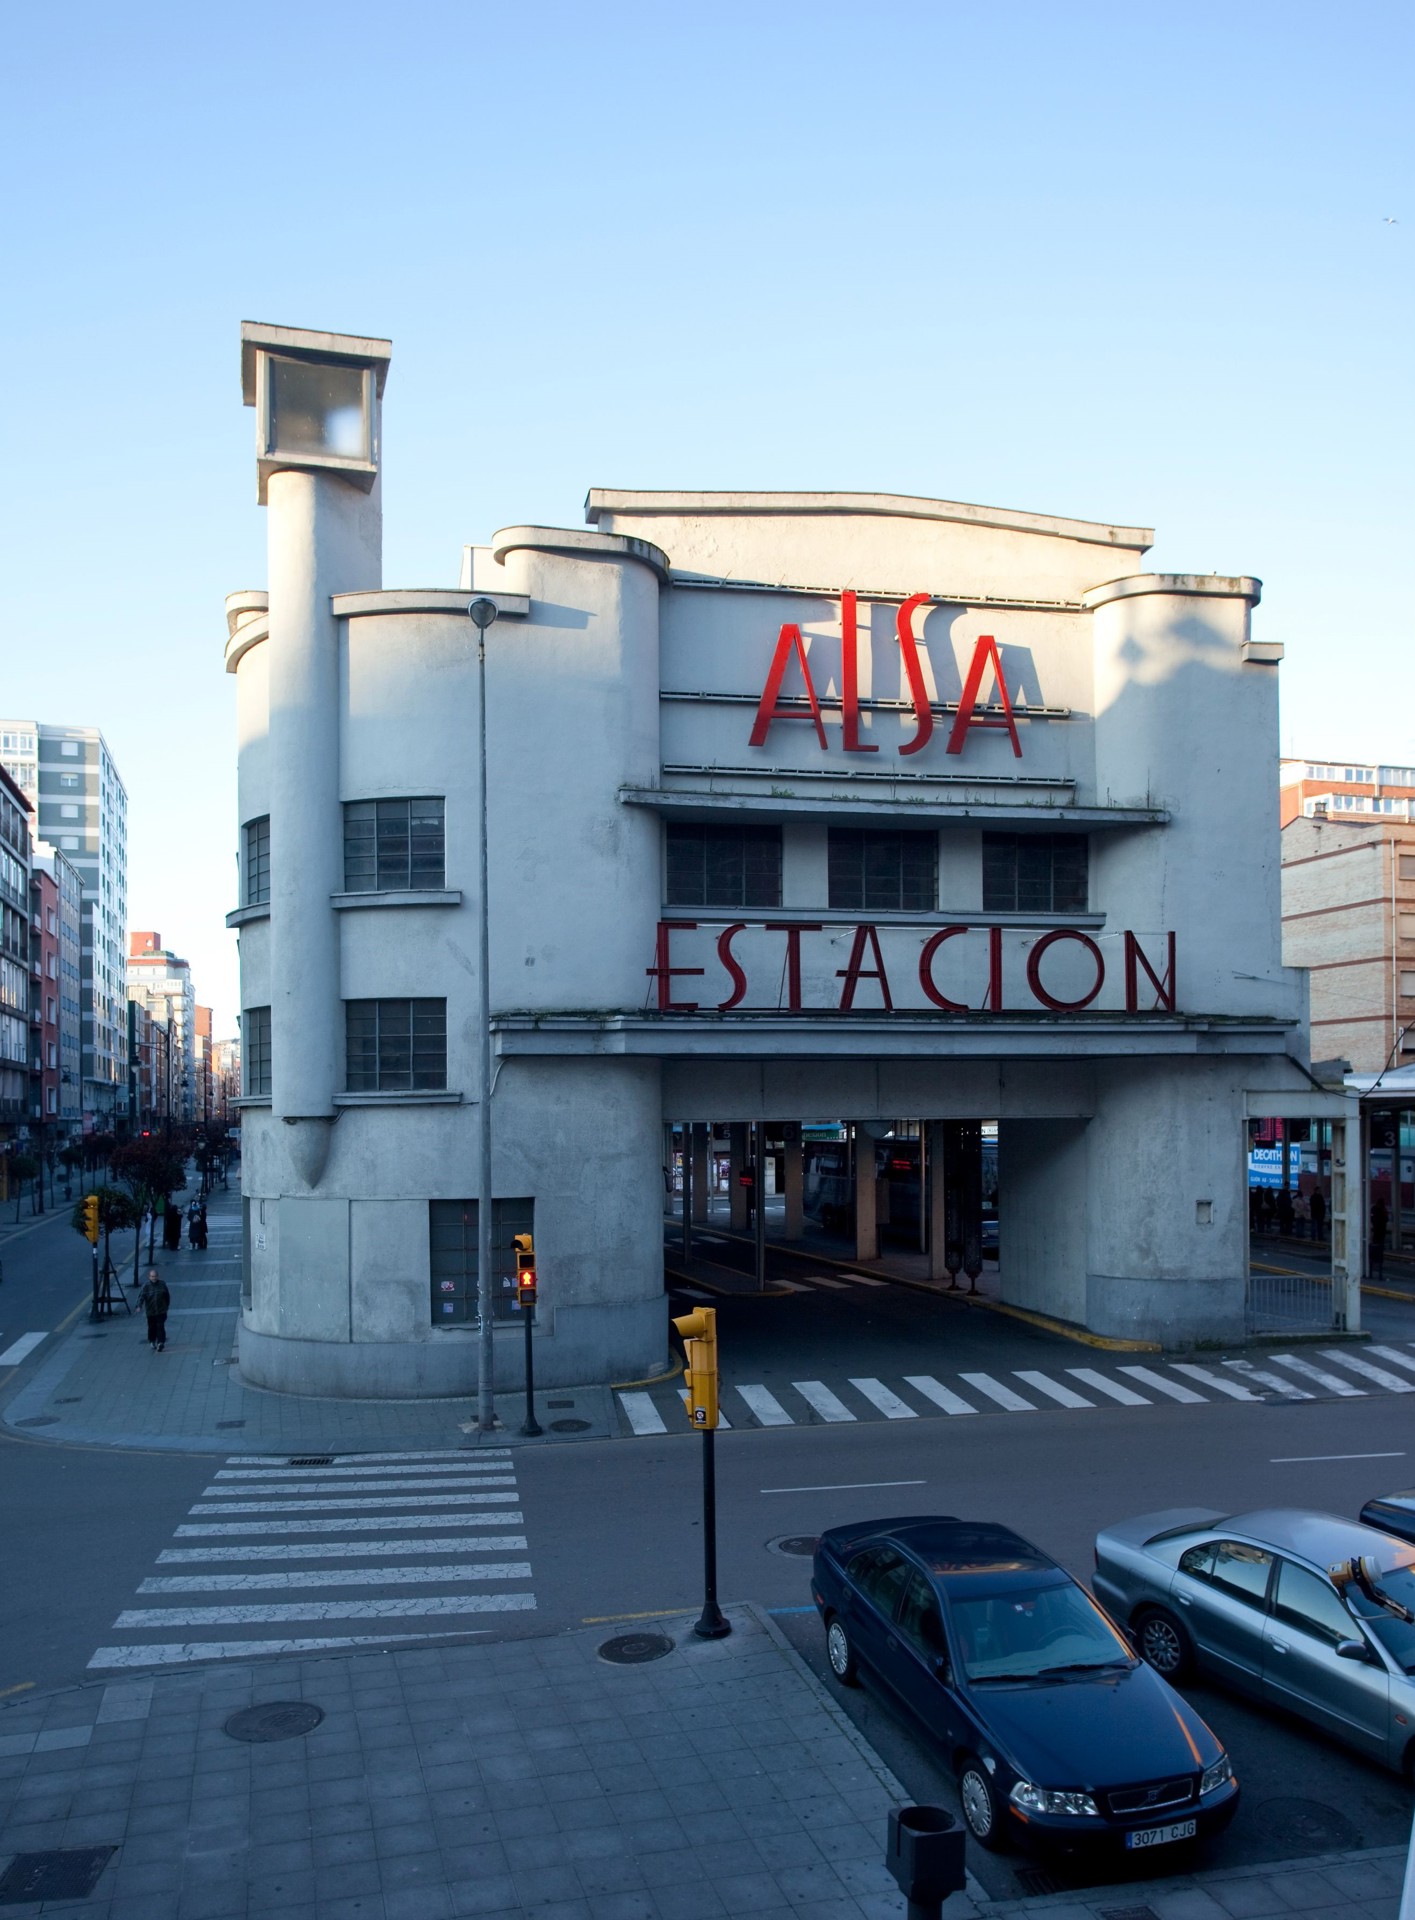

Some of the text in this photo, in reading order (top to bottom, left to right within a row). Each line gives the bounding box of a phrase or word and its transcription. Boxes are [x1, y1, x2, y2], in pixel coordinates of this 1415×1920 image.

[749, 590, 1022, 757] ALSA
[646, 921, 1176, 1013] ESTACION
[723, 1129, 731, 1139] 5
[1300, 1128, 1309, 1140] 2
[1383, 1131, 1396, 1147] 3
[1253, 1149, 1298, 1162] DECATHN
[1134, 1822, 1194, 1846] 3071 CJG
